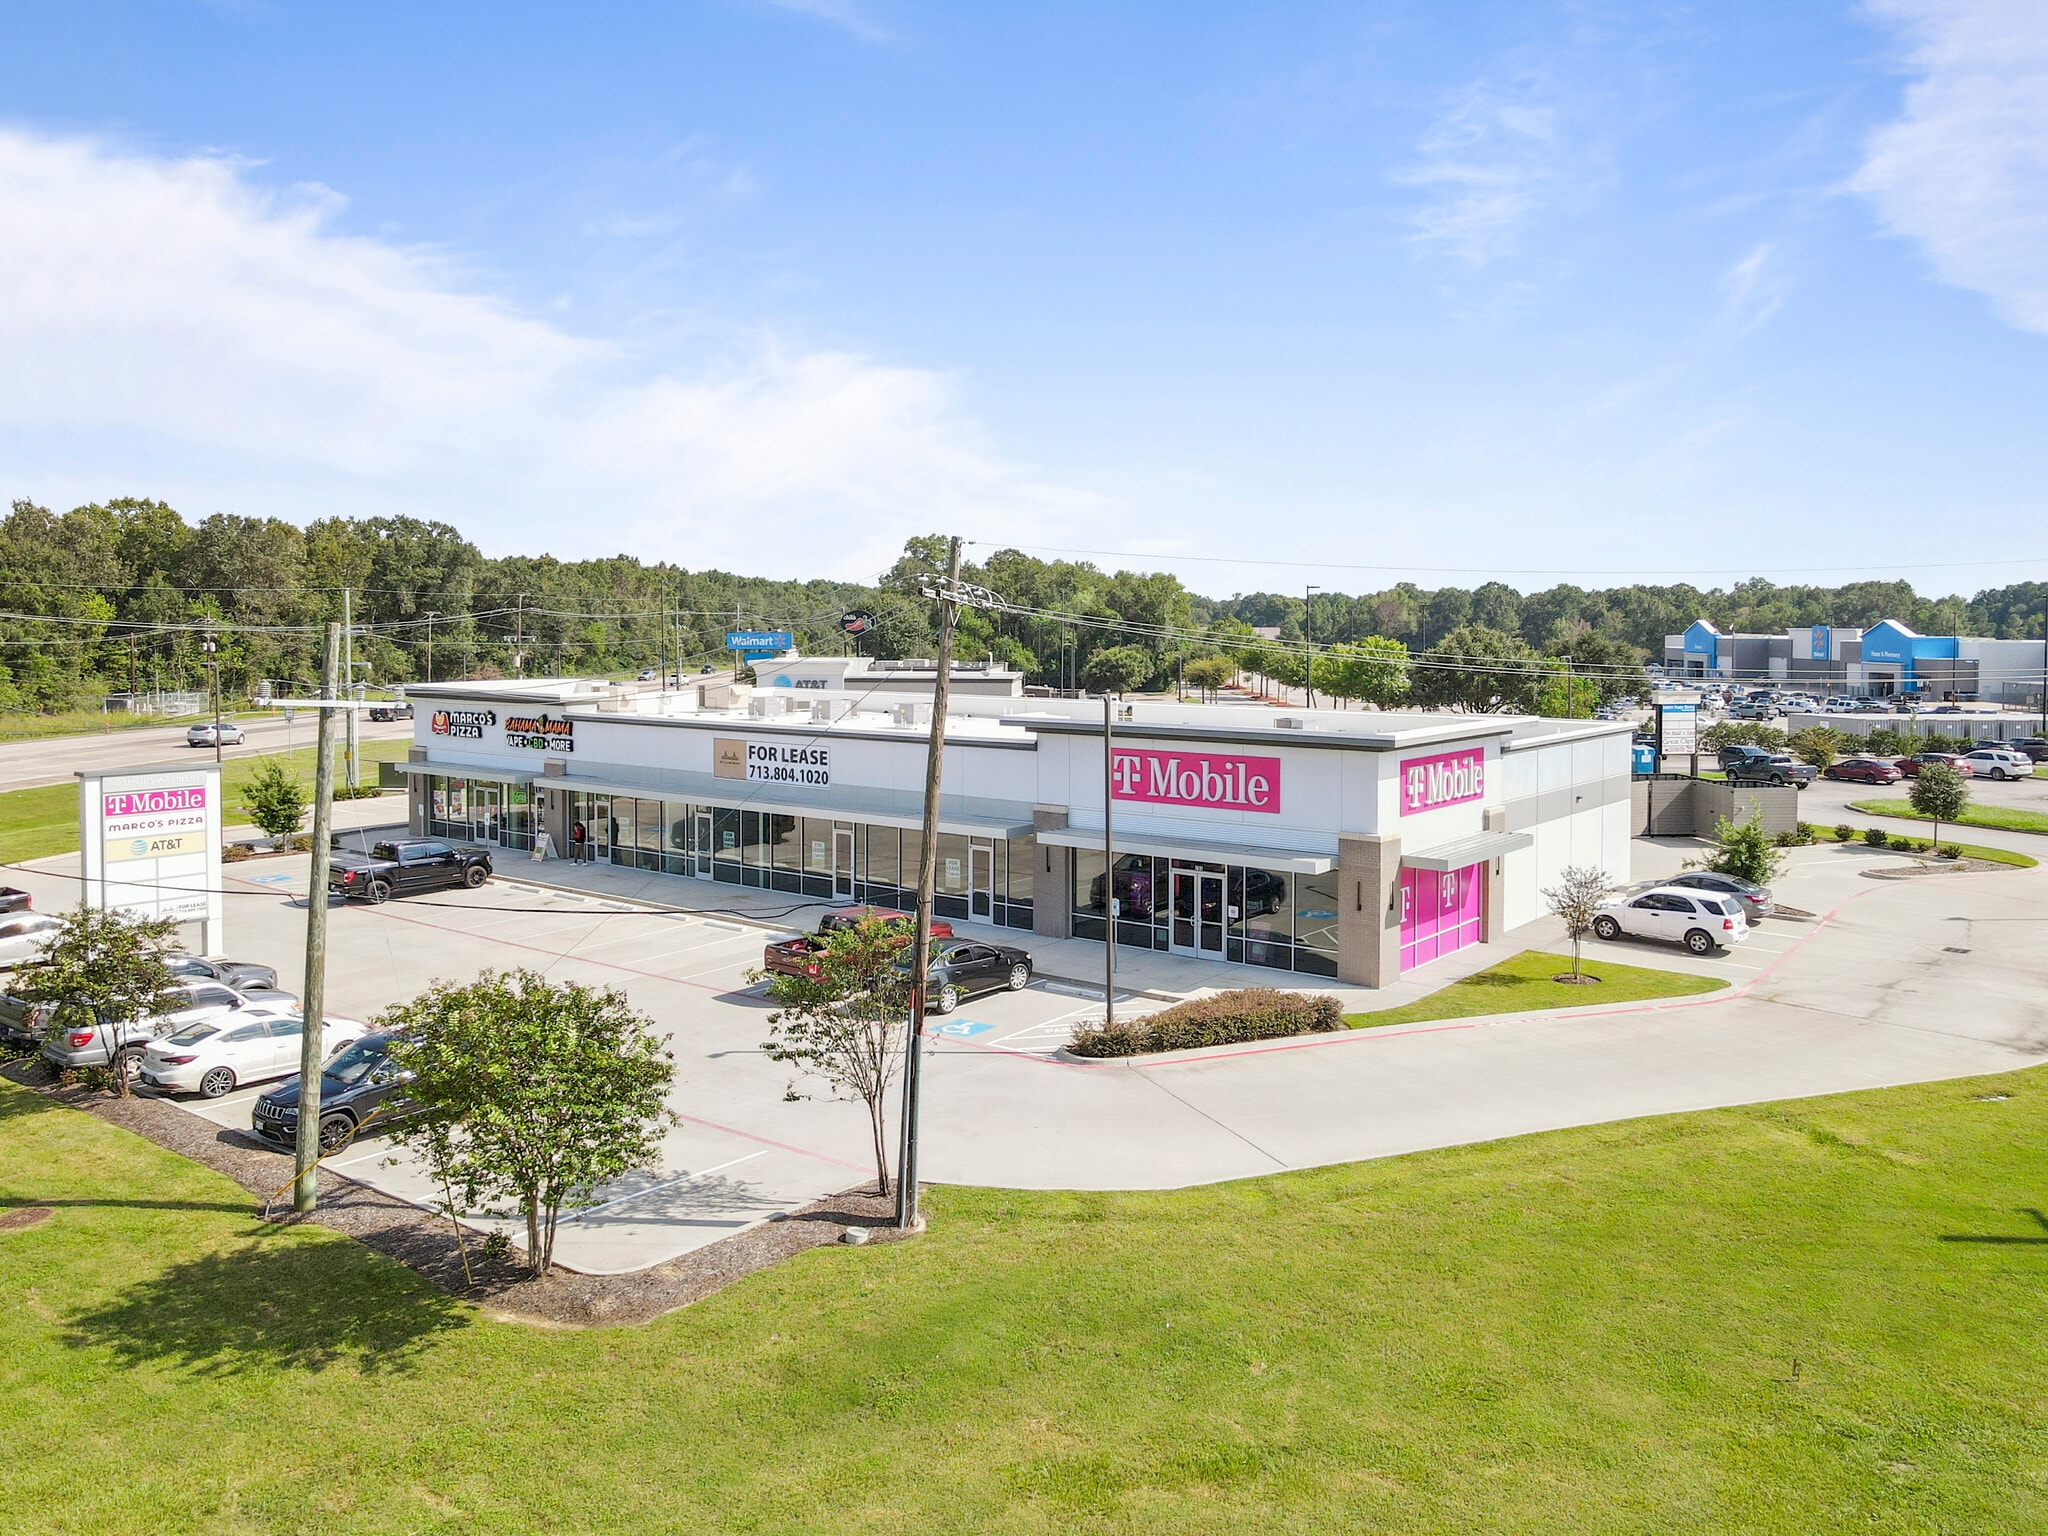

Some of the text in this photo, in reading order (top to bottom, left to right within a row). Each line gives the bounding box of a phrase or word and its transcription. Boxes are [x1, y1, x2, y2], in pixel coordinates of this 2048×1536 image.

[731, 636, 773, 646] Walmart
[795, 680, 828, 689] AT&T
[450, 711, 493, 725] MARCO'S
[505, 717, 570, 735] BAHAMA MAMA
[451, 726, 479, 738] PIZZA
[506, 735, 571, 752] VAPE CBD MORE
[748, 745, 828, 766] FOR LEASE
[749, 765, 829, 785] 713.804.1020
[1147, 756, 1270, 806] Mobile
[1424, 756, 1483, 804] Mobile
[131, 790, 202, 813] Mobile
[109, 816, 203, 832] MARCO'S PIZZA
[151, 838, 183, 852] AT&T
